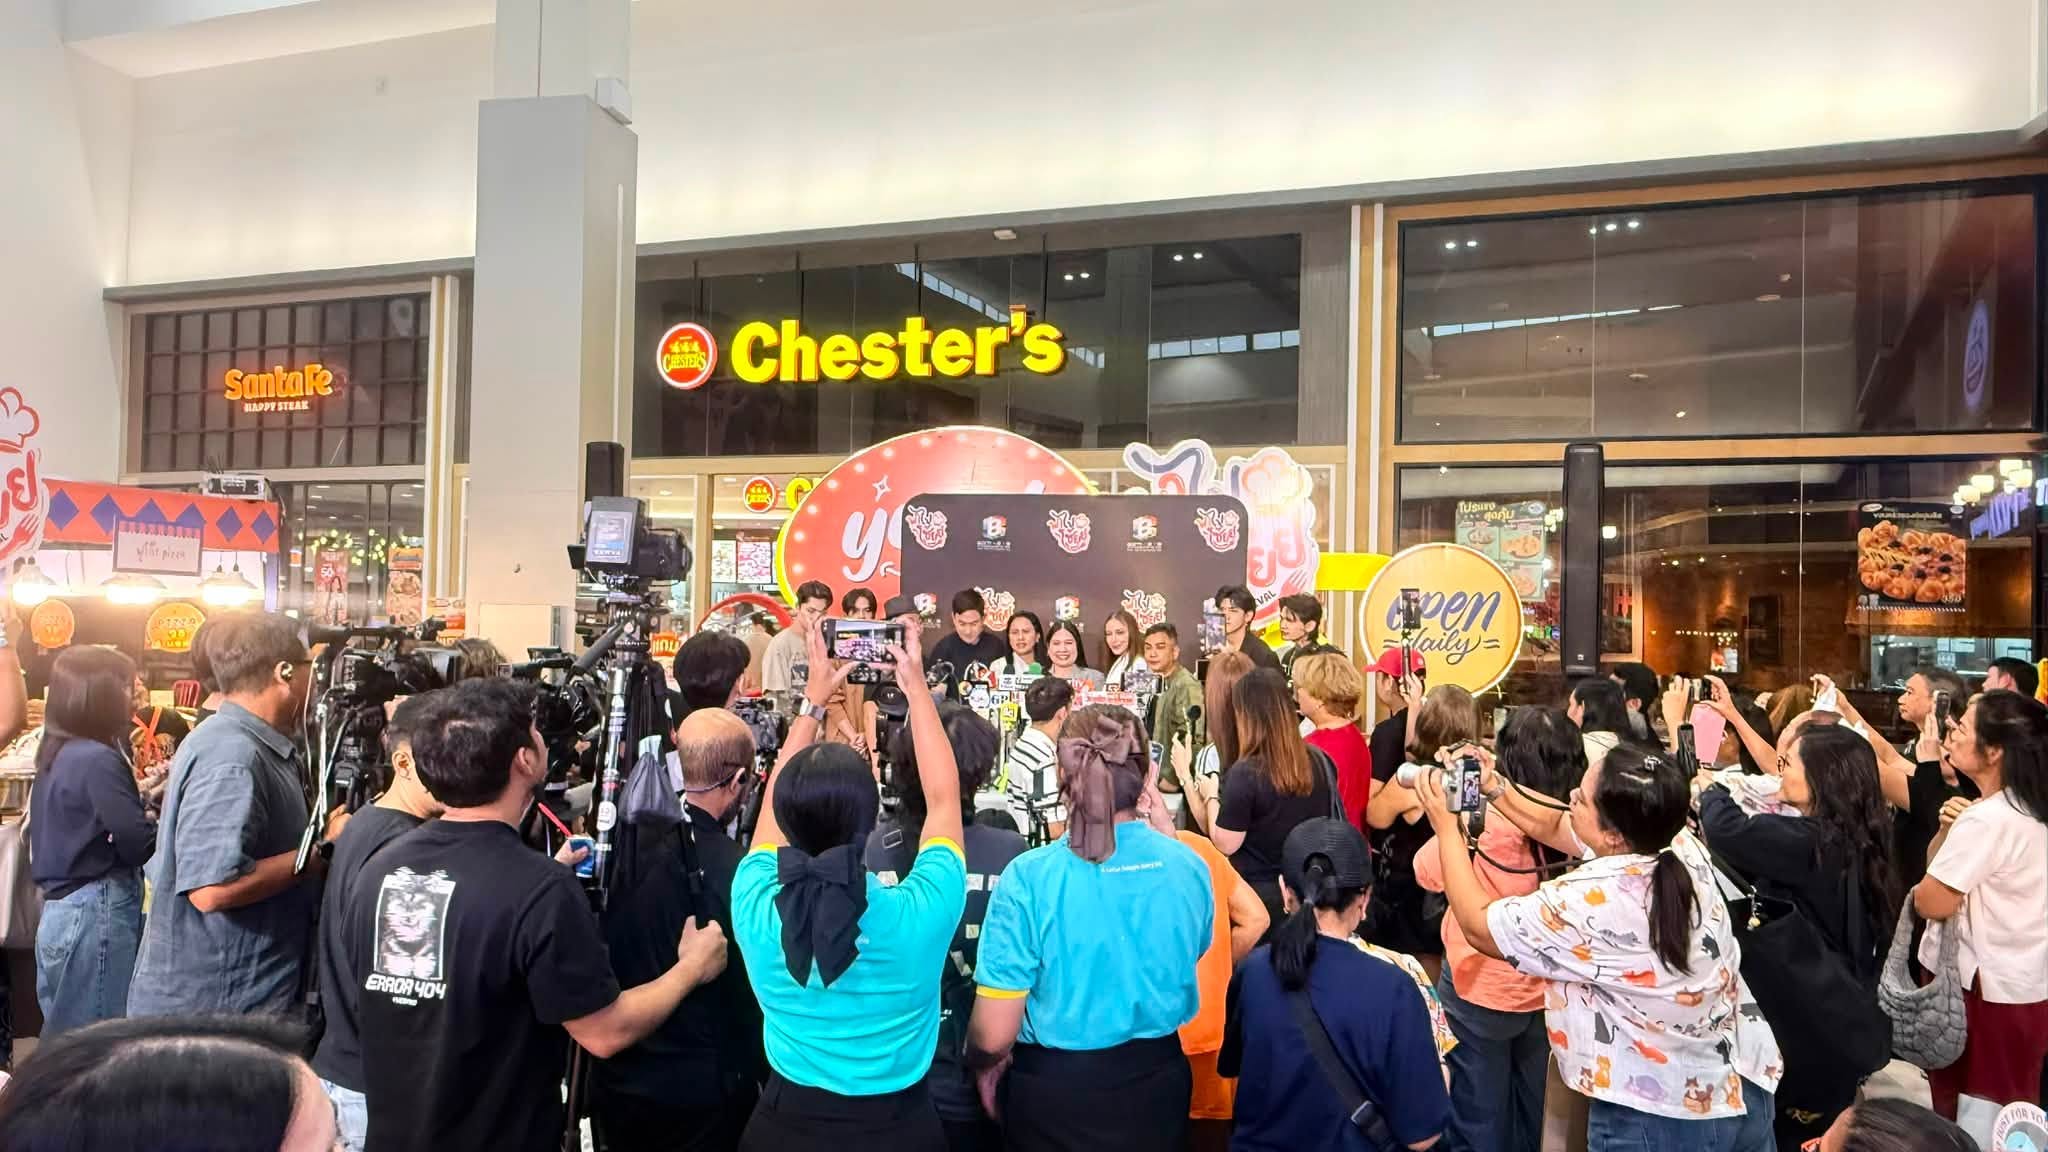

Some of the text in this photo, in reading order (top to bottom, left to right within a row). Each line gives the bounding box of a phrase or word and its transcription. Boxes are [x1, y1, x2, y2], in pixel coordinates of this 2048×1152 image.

[731, 310, 1065, 384] Chester's
[244, 400, 309, 412] HAPPY STEAK
[365, 973, 447, 1000] ERROR 404
